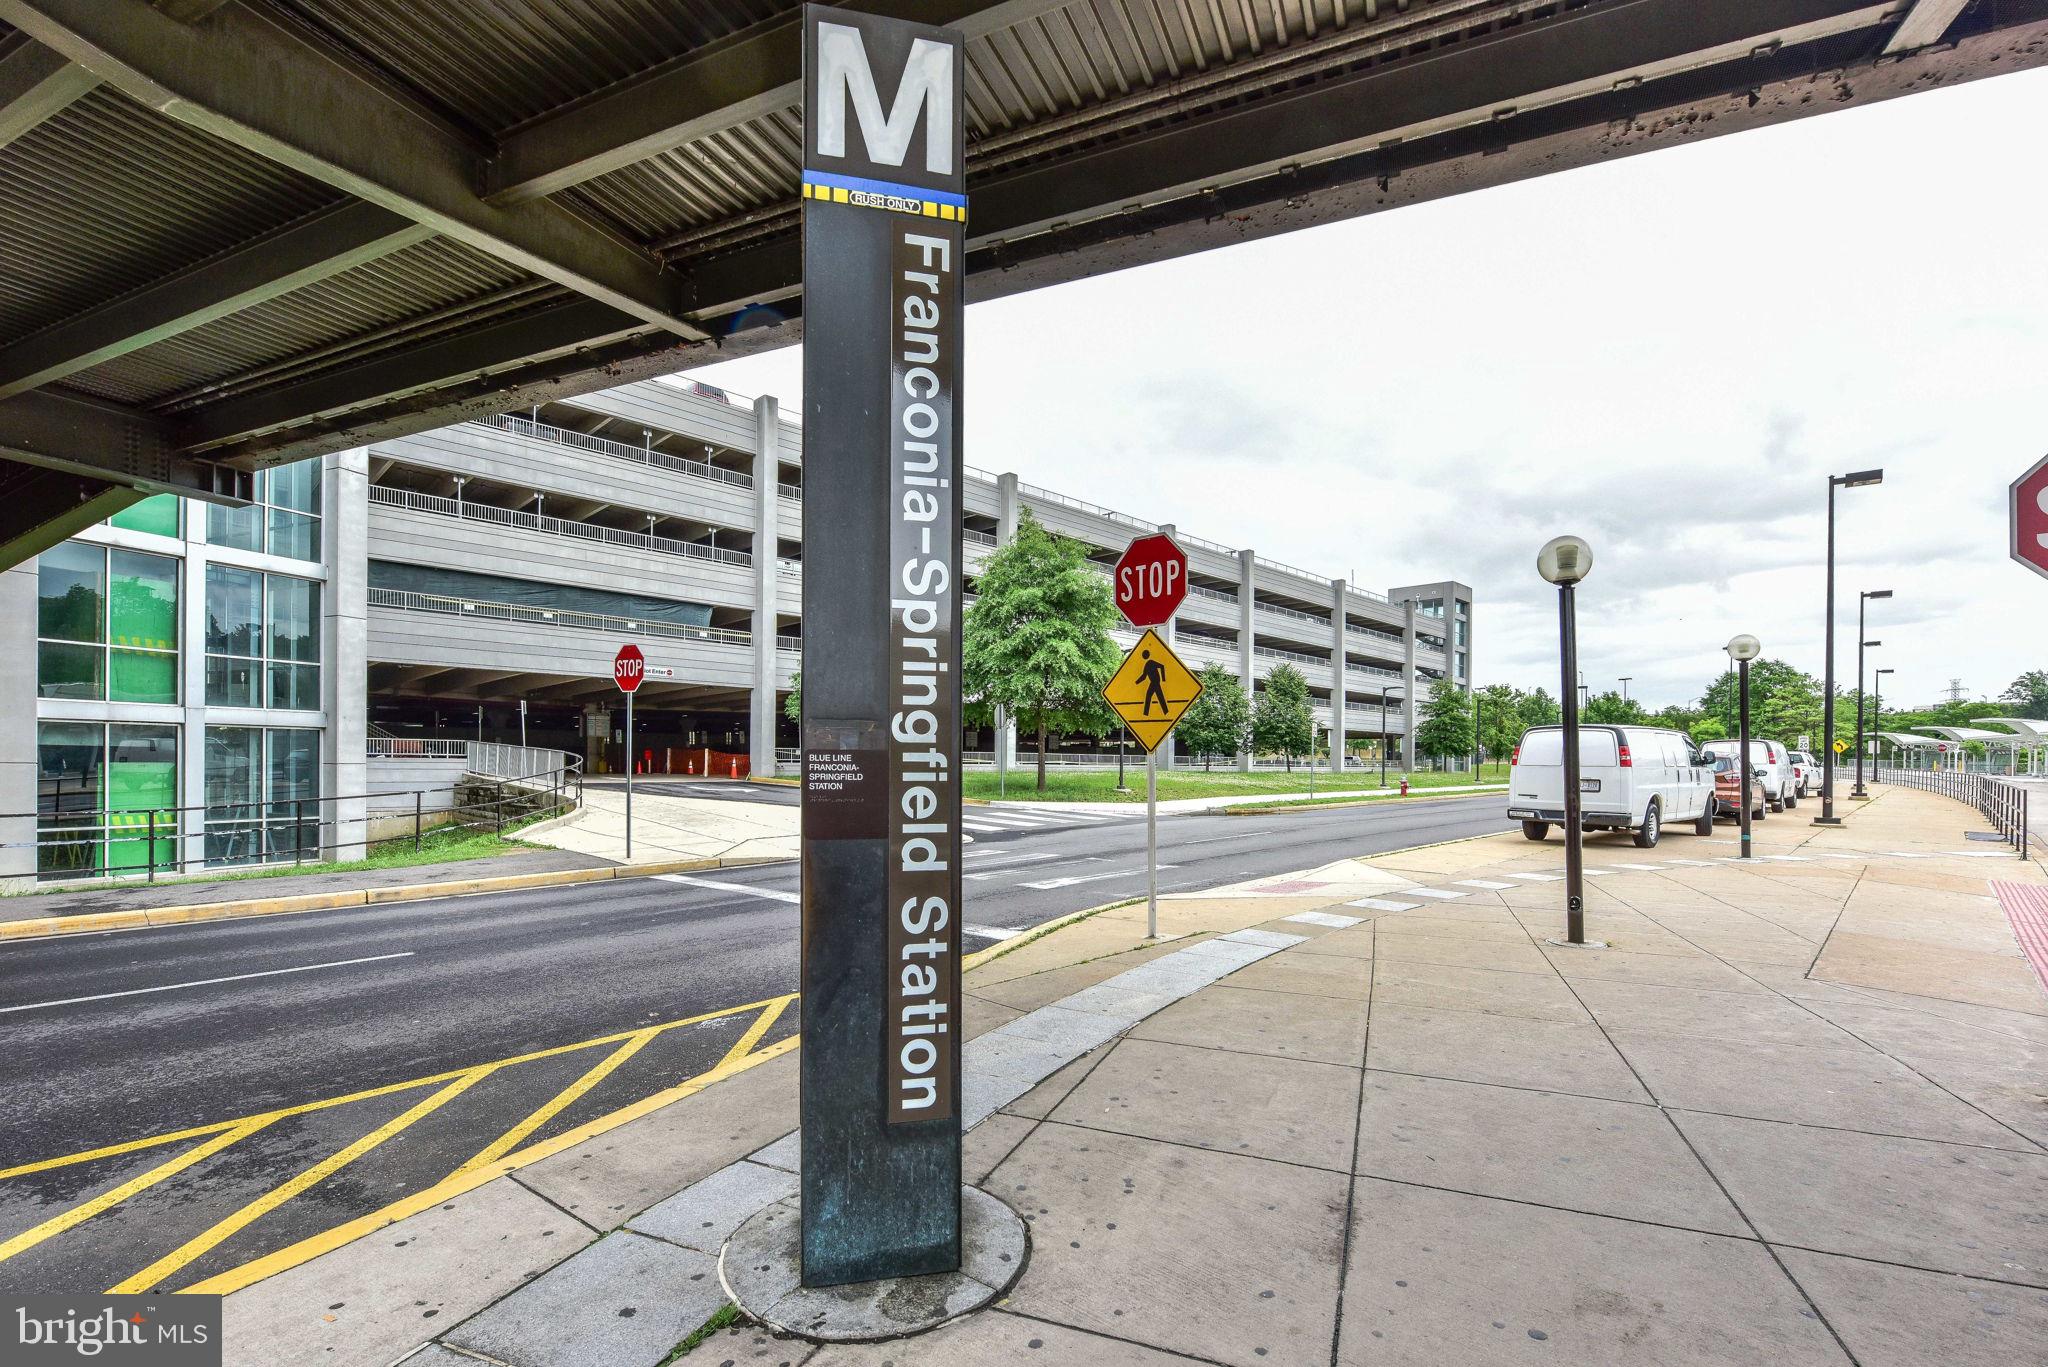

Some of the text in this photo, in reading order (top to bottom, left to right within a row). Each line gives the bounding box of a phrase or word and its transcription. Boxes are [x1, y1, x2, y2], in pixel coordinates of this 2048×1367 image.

[818, 21, 953, 175] M
[855, 194, 915, 211] RUSH ONLY
[1120, 559, 1180, 602] STOP
[616, 659, 643, 677] STOP
[809, 754, 852, 762] BLUE LINE
[809, 773, 864, 781] SPRINGFIELD
[809, 782, 843, 790] STATION
[900, 896, 949, 1110] Station
